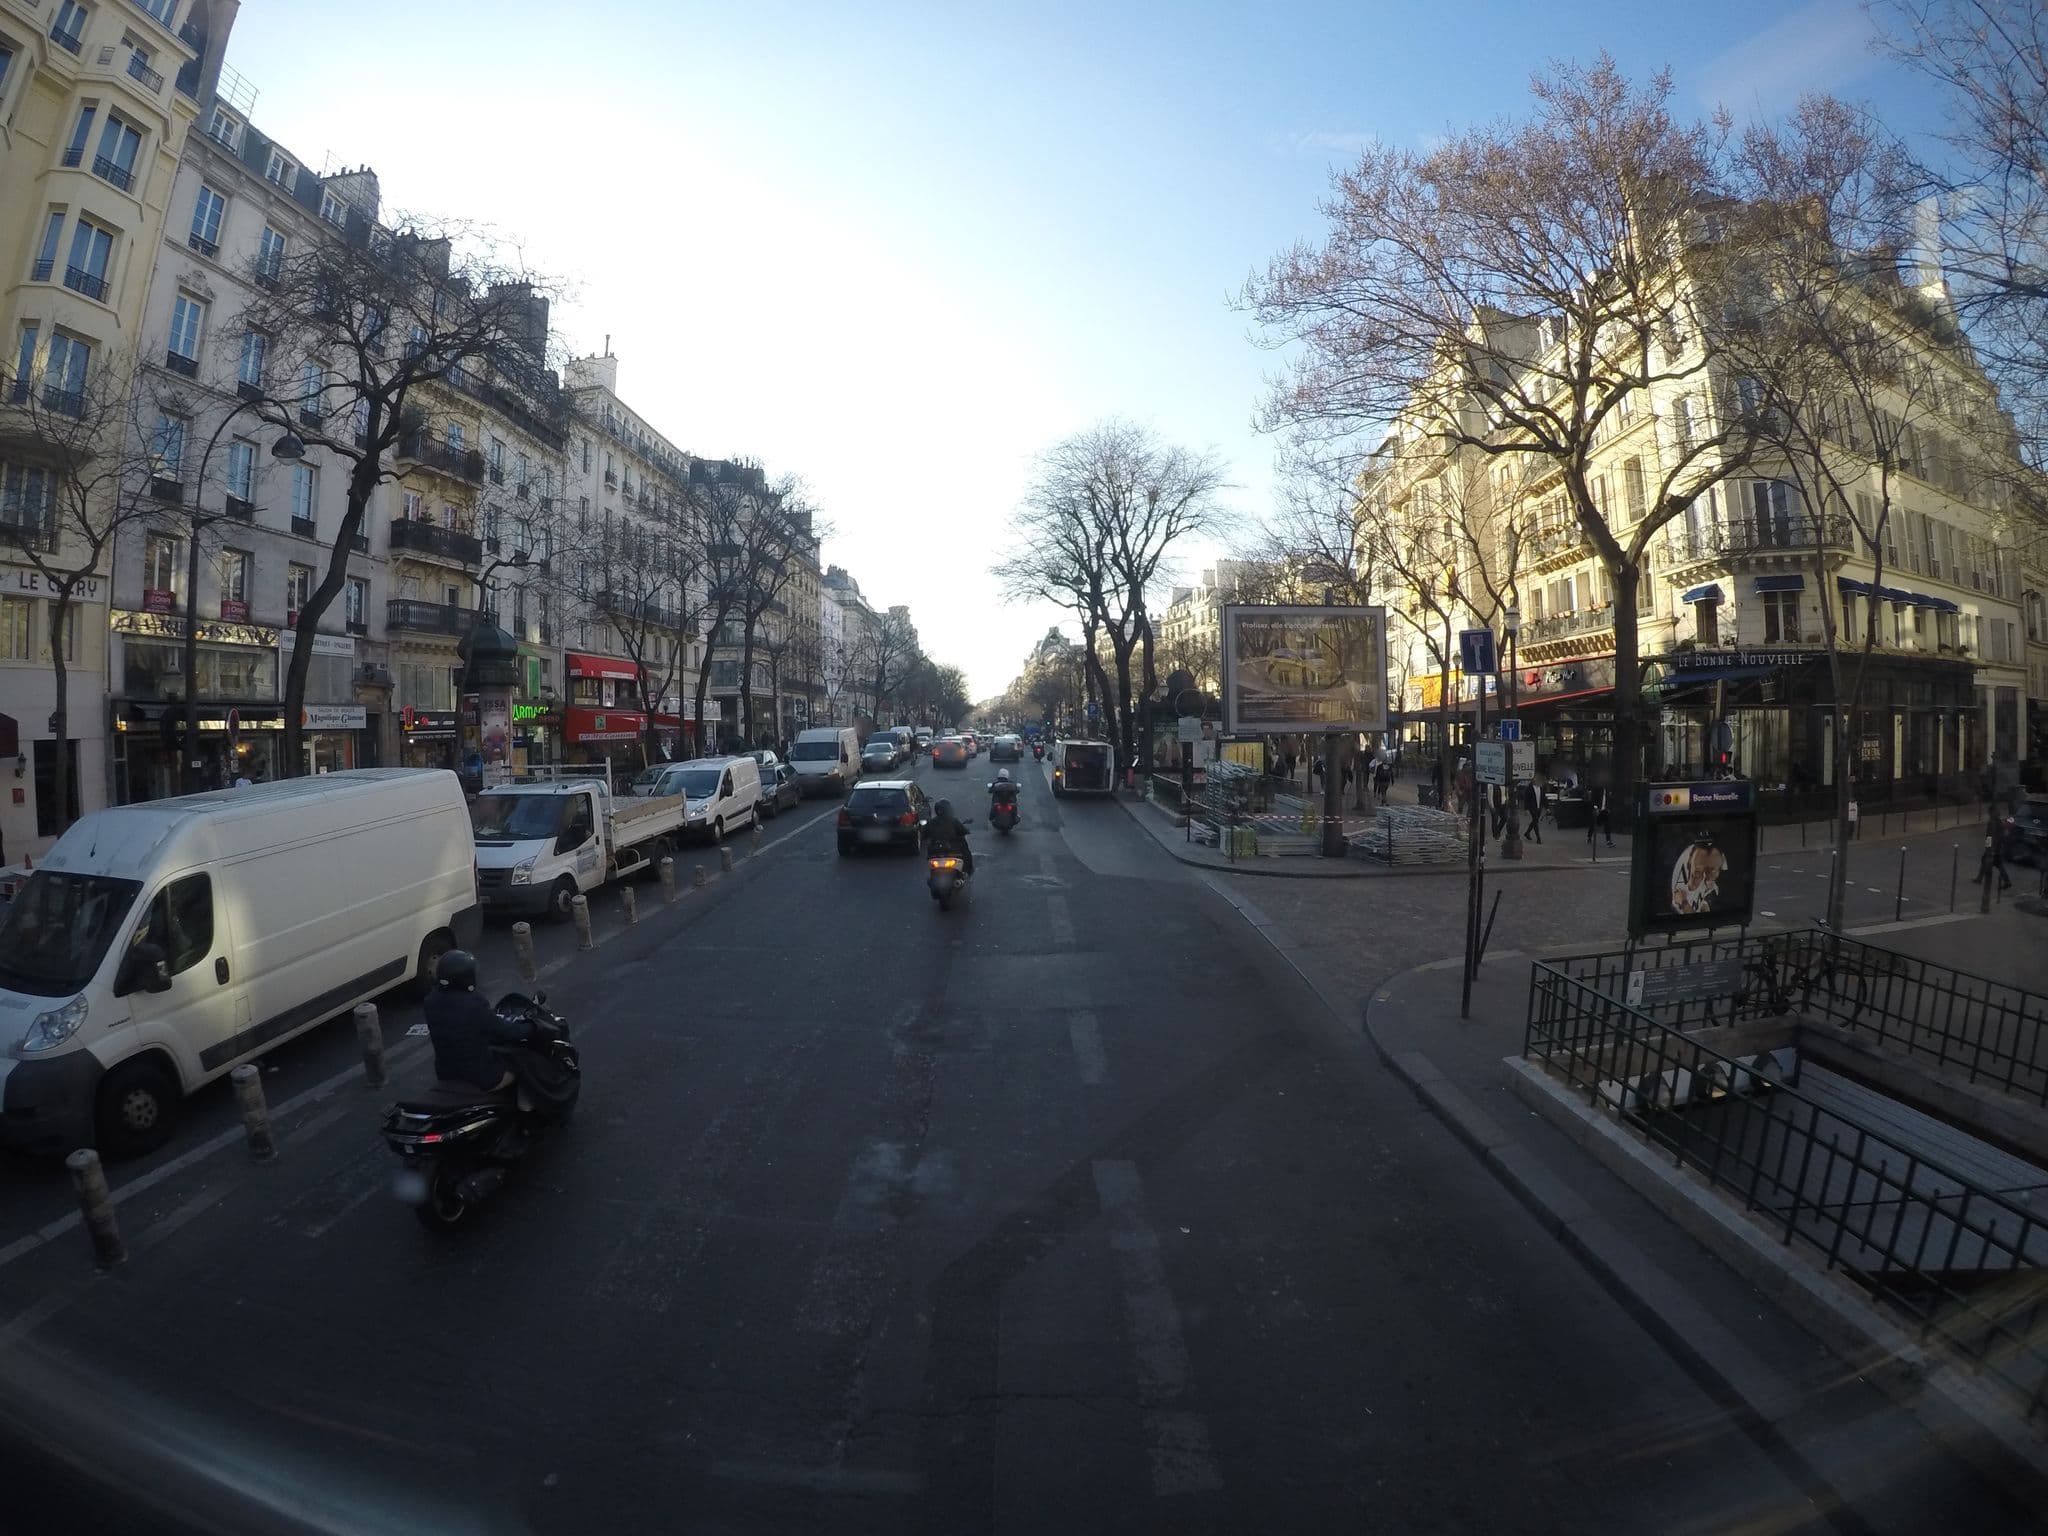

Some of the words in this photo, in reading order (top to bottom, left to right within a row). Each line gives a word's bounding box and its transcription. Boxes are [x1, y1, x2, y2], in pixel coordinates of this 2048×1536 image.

[20, 571, 39, 590] LE
[1679, 656, 1688, 667] LE
[1695, 654, 1732, 666] BONNE
[1741, 652, 1803, 665] NOUVELLE
[1693, 793, 1712, 802] Bonne
[1713, 792, 1739, 801] Nouvelle
